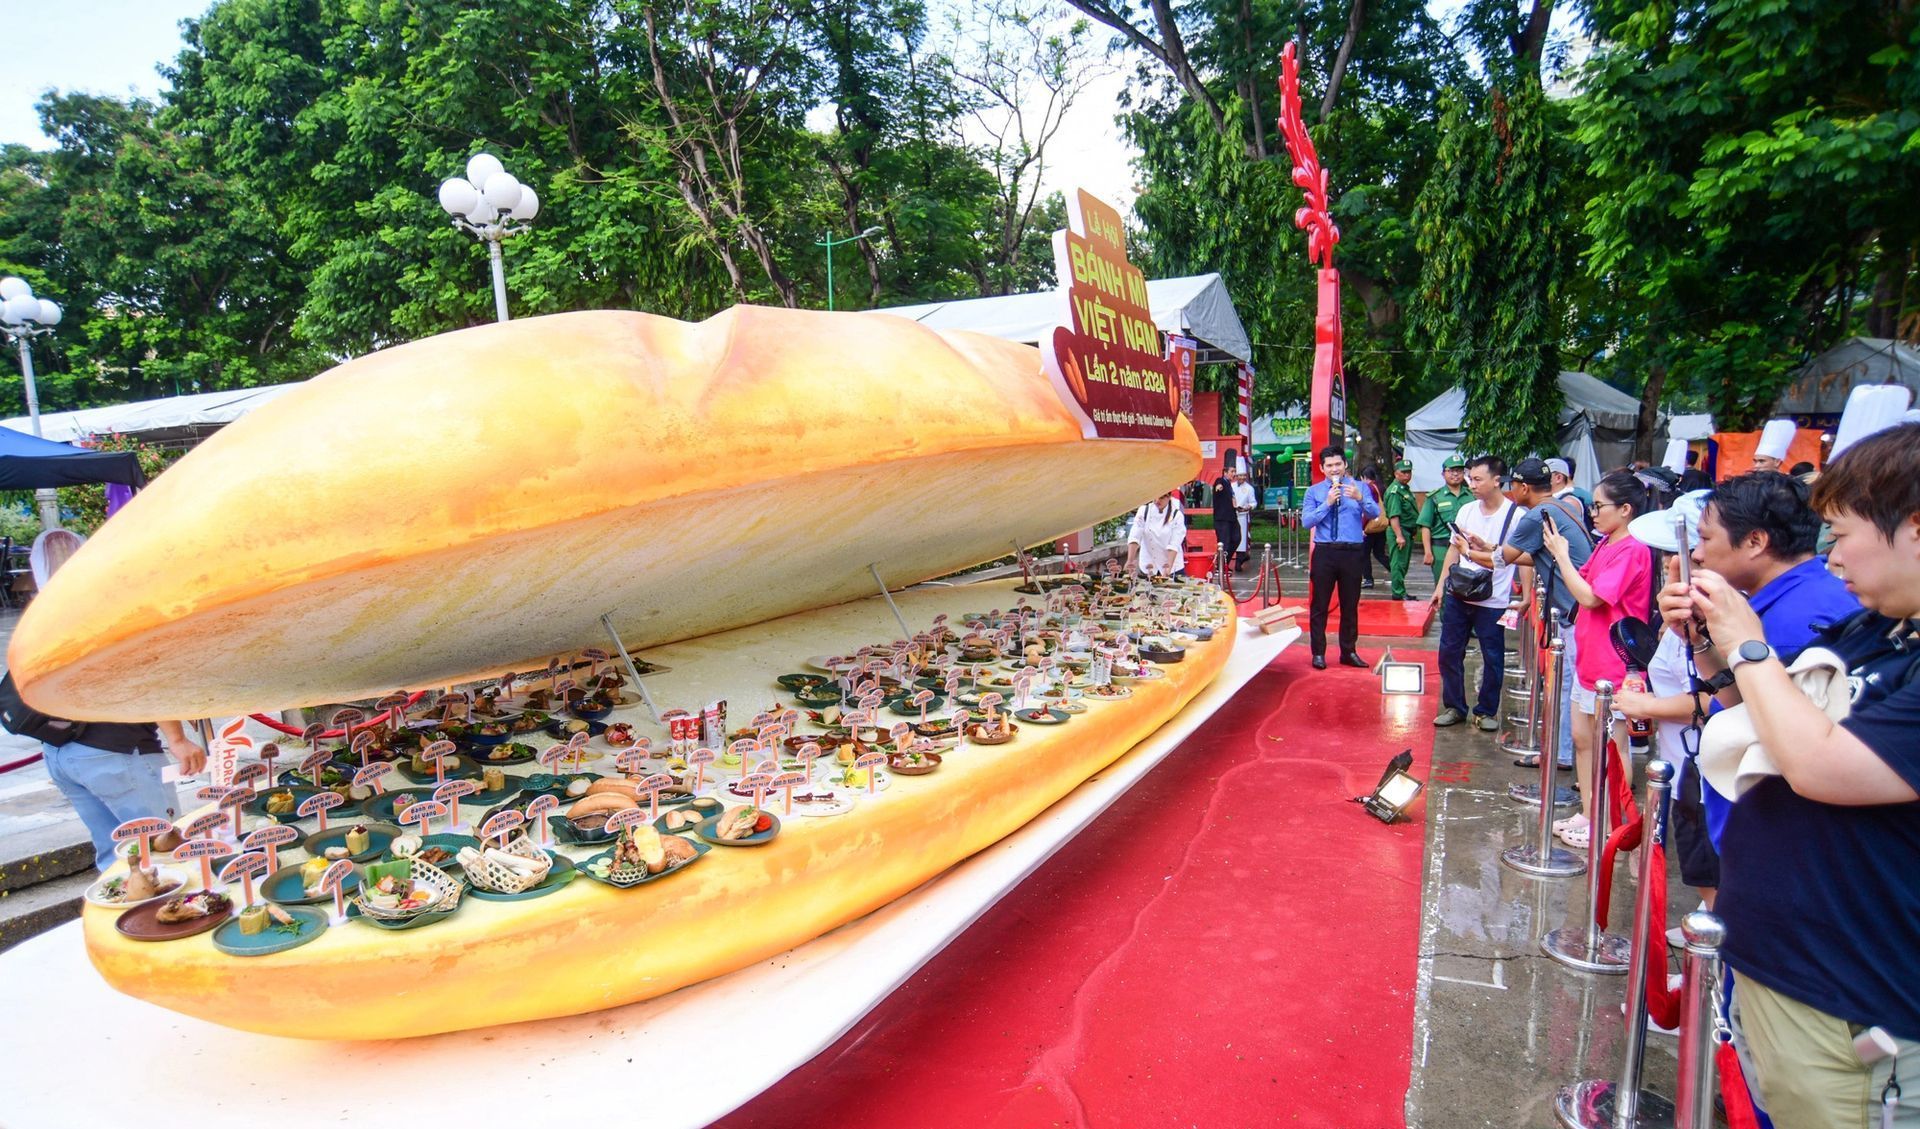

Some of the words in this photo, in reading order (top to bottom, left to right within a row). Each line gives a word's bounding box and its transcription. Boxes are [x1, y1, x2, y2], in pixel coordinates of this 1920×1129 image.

[1070, 242, 1126, 301] BÁNH
[1126, 269, 1148, 310] MÌ
[1073, 294, 1117, 350] VIỆT
[1120, 313, 1160, 357] NAM
[1084, 353, 1108, 383] Lần
[1109, 361, 1119, 385] 2
[1119, 365, 1142, 389] năm
[1141, 369, 1166, 394] 2024
[411, 806, 426, 814] Bánh
[118, 829, 132, 838] Bánh
[190, 842, 205, 850] Bánh
